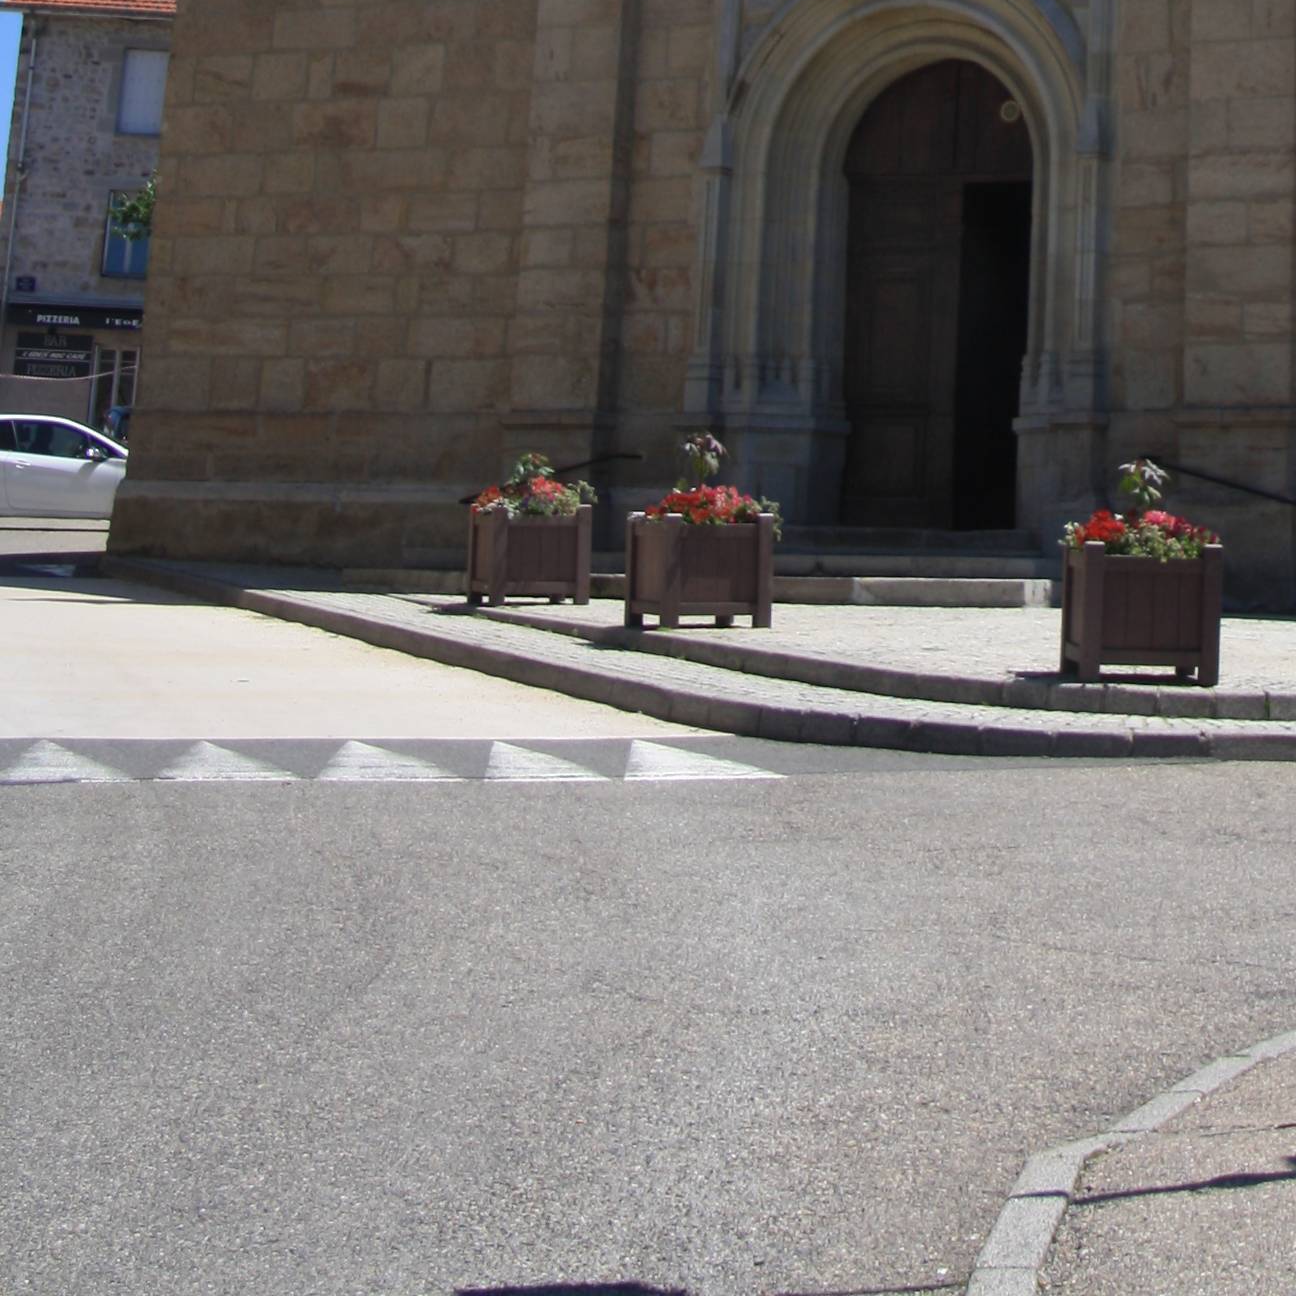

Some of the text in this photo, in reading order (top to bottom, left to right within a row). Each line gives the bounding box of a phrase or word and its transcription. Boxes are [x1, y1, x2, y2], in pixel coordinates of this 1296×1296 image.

[36, 314, 80, 325] PIZZERIA
[44, 335, 67, 348] BAR
[26, 363, 76, 377] PIZZERIA
